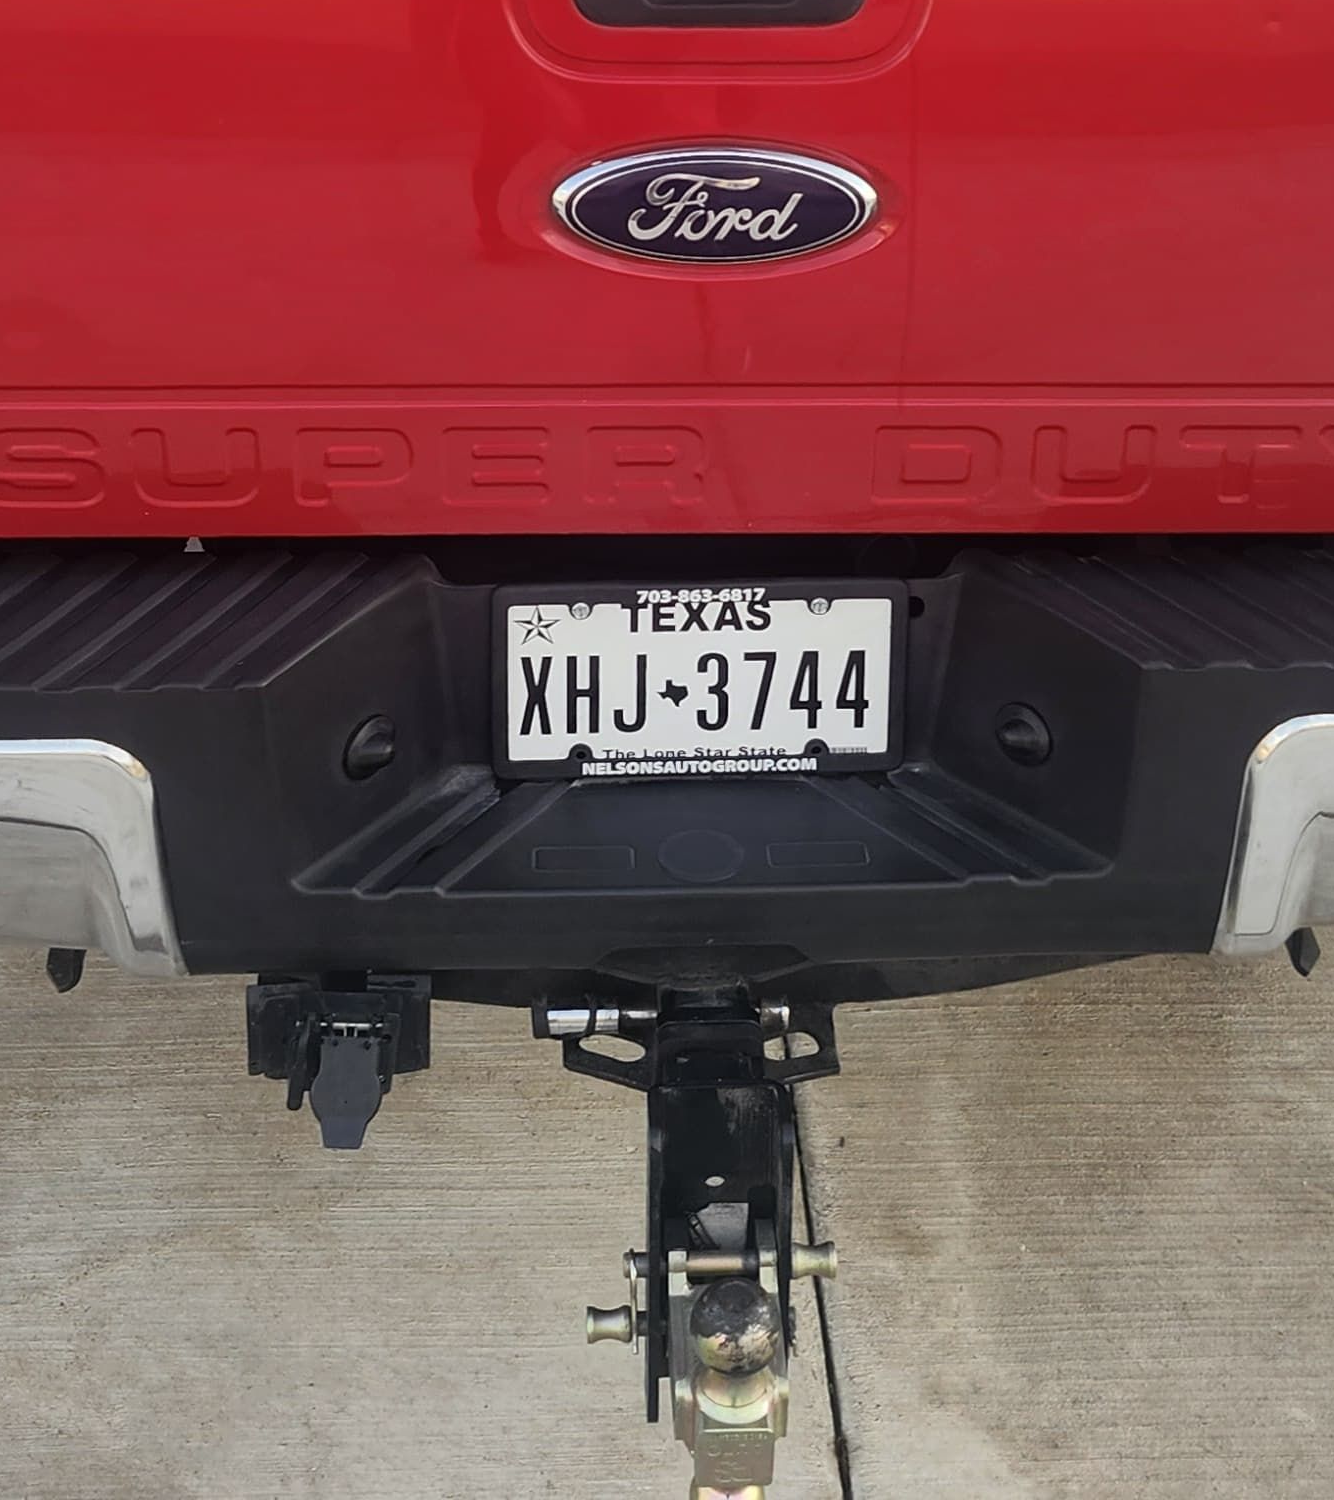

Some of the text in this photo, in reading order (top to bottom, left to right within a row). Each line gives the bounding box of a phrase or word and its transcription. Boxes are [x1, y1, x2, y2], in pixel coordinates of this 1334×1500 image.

[627, 172, 804, 242] Ford
[620, 601, 772, 633] TEXAS
[519, 649, 869, 736] XHJ 3744
[582, 757, 817, 776] NELSONSAUTOGROUP.COM
[694, 747, 733, 757] Star
[738, 746, 787, 757] State
